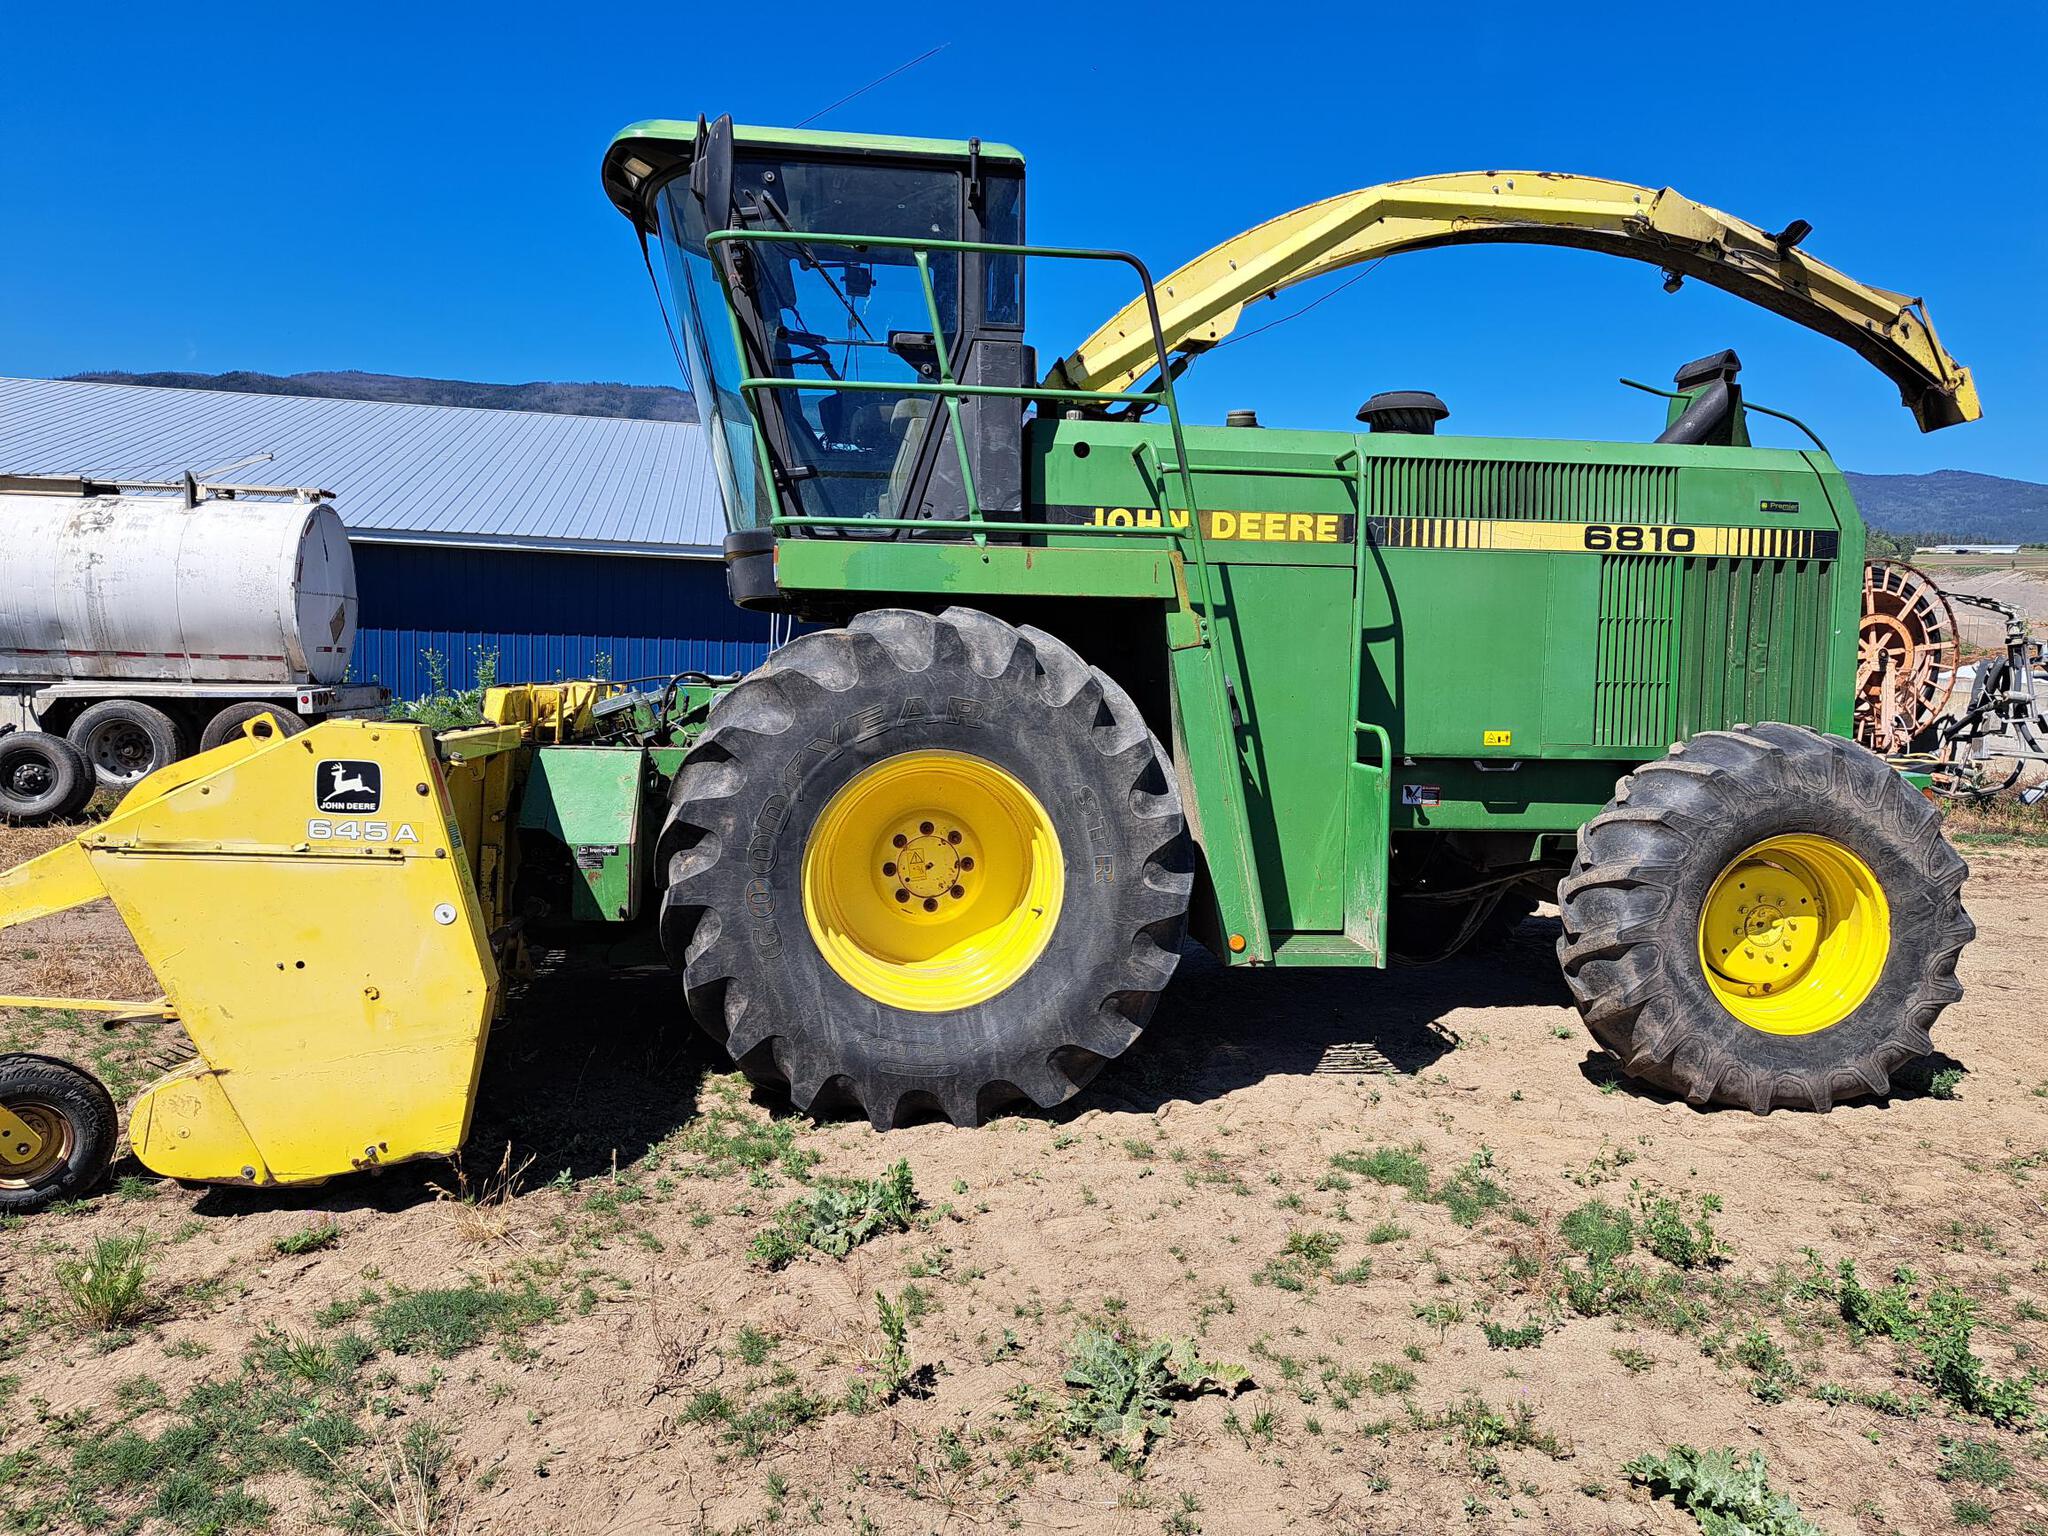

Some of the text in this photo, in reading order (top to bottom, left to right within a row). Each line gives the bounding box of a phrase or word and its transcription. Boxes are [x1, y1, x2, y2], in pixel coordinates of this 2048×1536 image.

[1211, 511, 1338, 541] DEERE
[1584, 525, 1695, 552] 6810
[320, 802, 376, 810] JOHN DEERE
[308, 819, 419, 843] 645A
[744, 696, 985, 959] GOODYEAR
